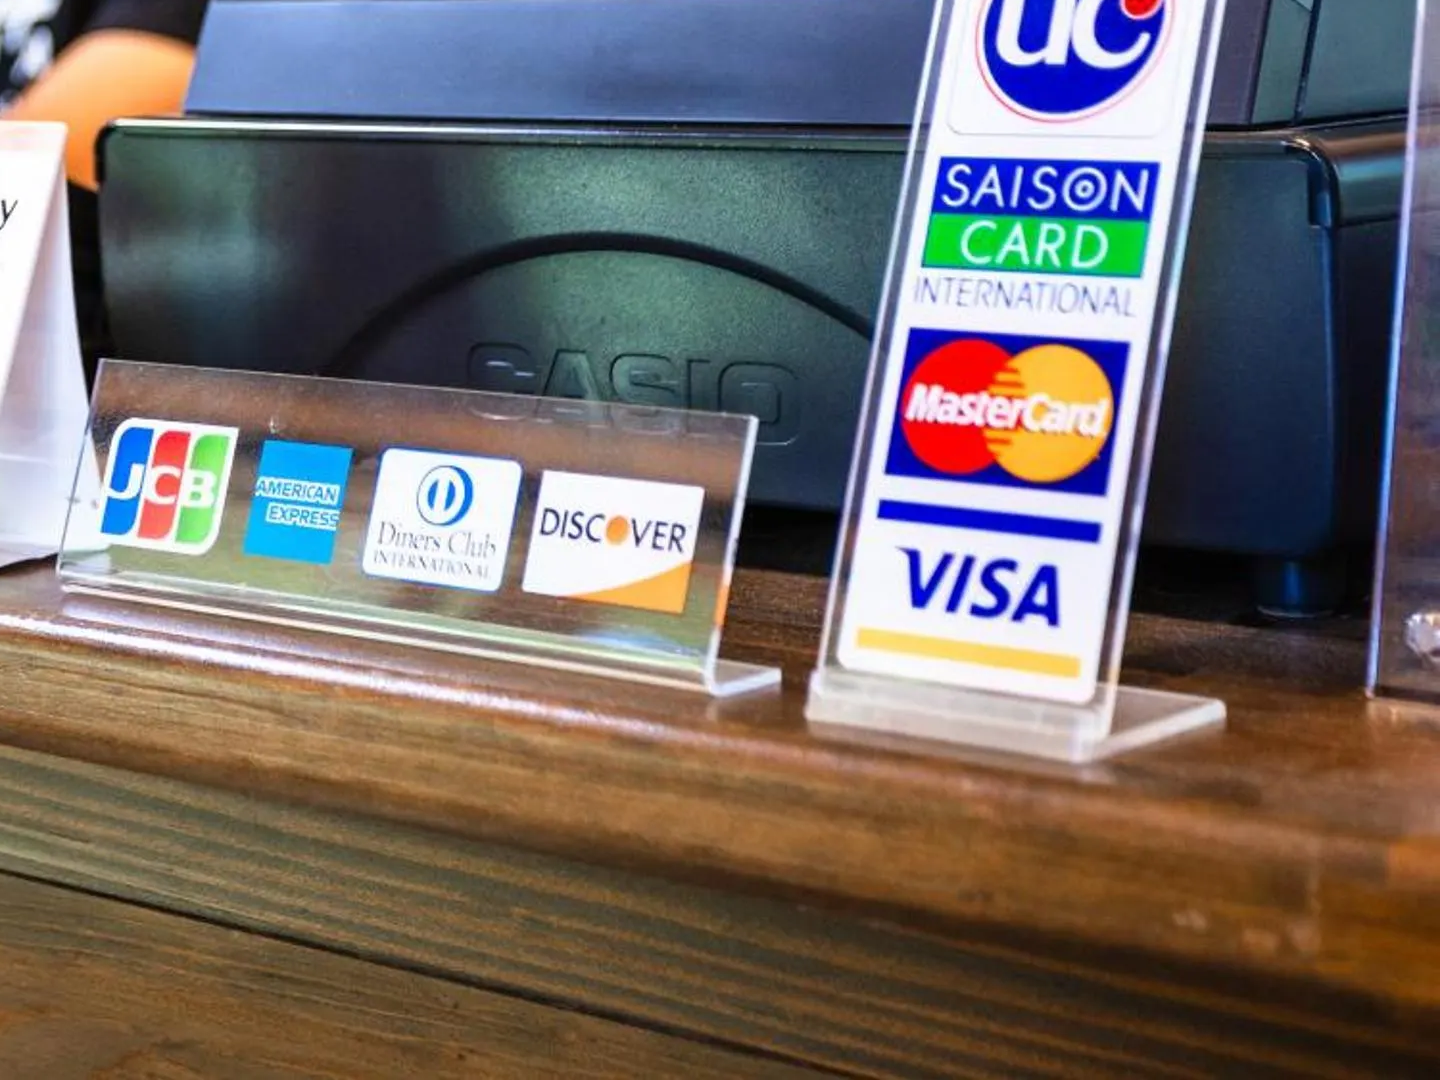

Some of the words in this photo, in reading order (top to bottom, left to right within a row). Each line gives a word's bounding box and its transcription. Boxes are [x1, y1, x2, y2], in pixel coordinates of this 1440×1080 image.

[941, 163, 1149, 213] SAISON
[960, 219, 1109, 269] CARD
[913, 276, 1137, 317] INTERNATIONAL
[466, 341, 801, 446] CASIO
[904, 383, 1107, 438] MasterCard
[106, 463, 218, 509] JCB
[256, 478, 337, 502] AMERICAN
[268, 505, 339, 528] EXPRESS
[539, 507, 687, 554] DISCOVER
[376, 521, 442, 554] Diners
[448, 530, 497, 560] Club
[372, 549, 492, 580] INTERNATIONAL
[896, 546, 1061, 628] VISA
